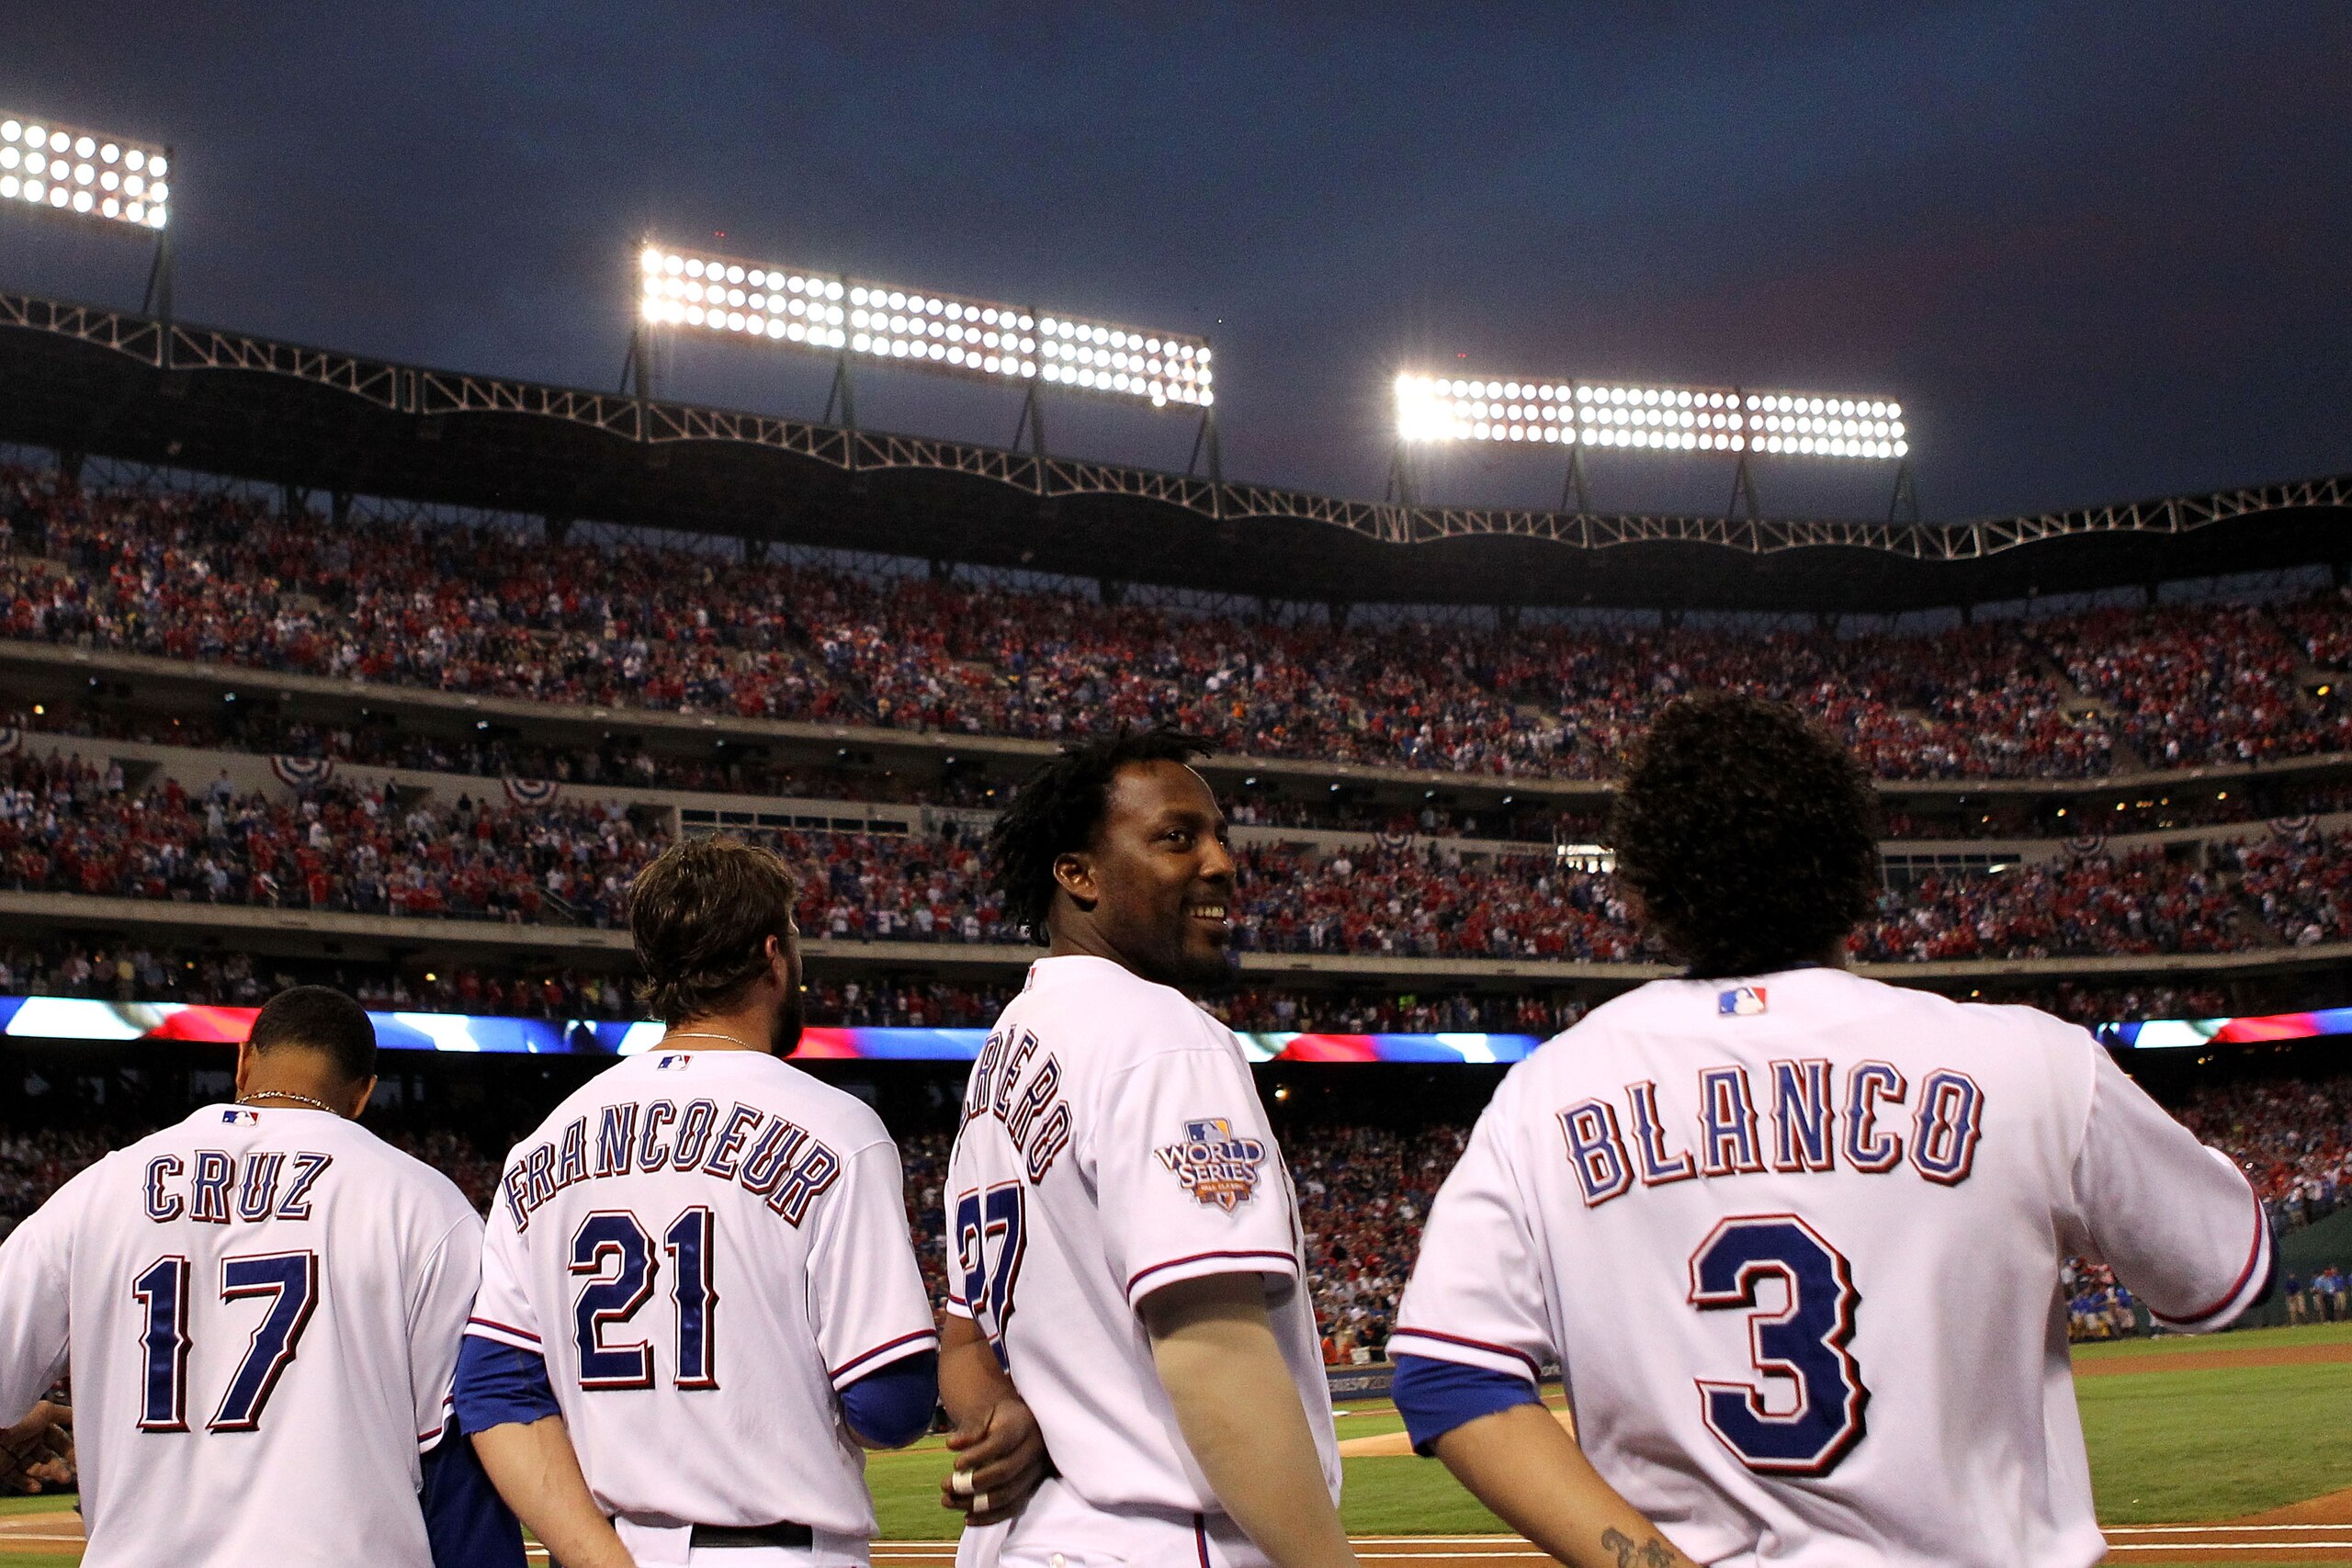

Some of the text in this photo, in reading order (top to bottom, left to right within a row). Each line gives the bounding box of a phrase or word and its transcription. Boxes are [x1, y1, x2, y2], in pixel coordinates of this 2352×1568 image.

[143, 1149, 333, 1224] CRUZ
[502, 1098, 840, 1234] FRANCOEUR
[1154, 1139, 1265, 1170] WORLD
[1178, 1162, 1259, 1189] SERIES
[1557, 1058, 1984, 1208] BLANCO
[133, 1250, 319, 1434] 17
[568, 1205, 719, 1390] 21
[955, 1179, 1027, 1375] 27
[1688, 1213, 1871, 1477] 3
